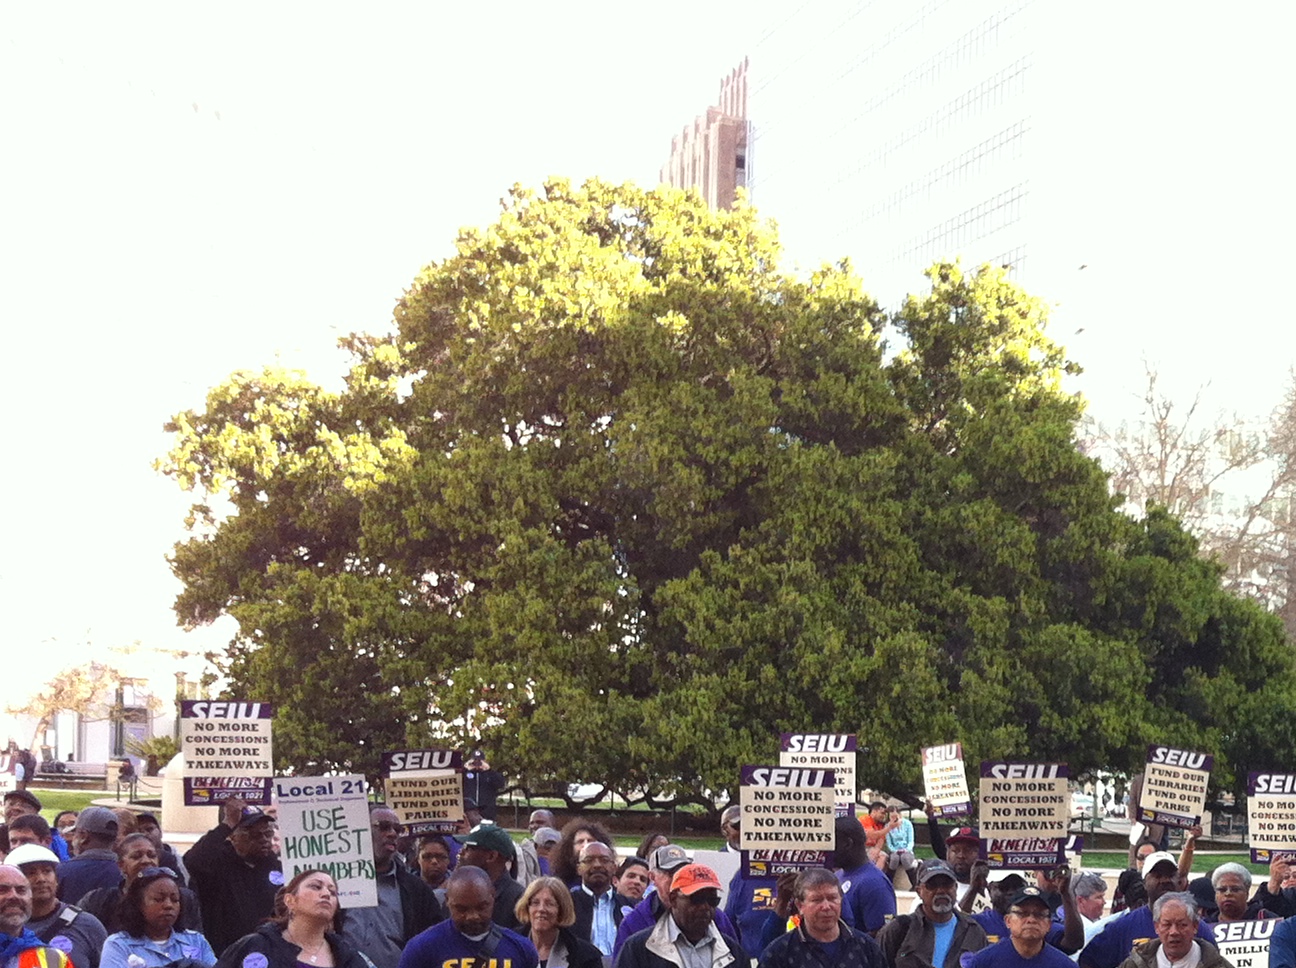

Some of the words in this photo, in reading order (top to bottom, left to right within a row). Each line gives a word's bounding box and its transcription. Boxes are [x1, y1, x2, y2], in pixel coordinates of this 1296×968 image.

[190, 702, 261, 719] SEIU
[194, 723, 214, 732] NO
[218, 723, 259, 732] MORE
[185, 735, 268, 744] CONCESSIONS
[787, 734, 848, 752] SEIU
[195, 748, 215, 756] NO
[219, 748, 260, 756] MORE
[925, 744, 957, 763] SEIU
[389, 751, 453, 770] SEIU
[791, 756, 807, 764] NO
[810, 756, 845, 764] MORE
[1152, 747, 1206, 769] SEIU
[186, 761, 269, 769] TAKEAWAYS
[750, 768, 825, 788] SEIU
[1151, 768, 1180, 779] FUND
[1182, 772, 1204, 783] OUR
[392, 780, 428, 788] FUND
[431, 778, 458, 787] OUR
[992, 783, 1011, 792] NO
[1015, 783, 1055, 792] MORE
[1147, 778, 1204, 793] LIBRARIES
[277, 781, 334, 797] Local
[341, 780, 364, 794] 21
[390, 787, 460, 798] LIBRARIES
[754, 791, 775, 801] NO
[779, 791, 822, 801] MORE
[983, 796, 1064, 804] CONCESSIONS
[1147, 788, 1177, 799] FUND
[1179, 793, 1201, 805] OUR
[393, 801, 428, 809] FUND
[431, 799, 459, 808] OUR
[1155, 800, 1191, 812] PARKS
[1258, 801, 1274, 809] NO
[744, 805, 831, 814] CONCESSIONS
[992, 808, 1011, 816] NO
[1015, 808, 1055, 816] MORE
[302, 805, 348, 832] USE
[405, 810, 448, 820] PARKS
[754, 818, 775, 827] NO
[779, 818, 822, 828] MORE
[983, 821, 1063, 830] TAKEAWAYS
[744, 832, 832, 842] TAKEAWAYS
[285, 828, 369, 860] HONEST
[1007, 856, 1037, 864] LOCAL
[771, 865, 800, 874] LOCAL
[1213, 919, 1276, 942] SEIU
[1237, 958, 1252, 968] IN
